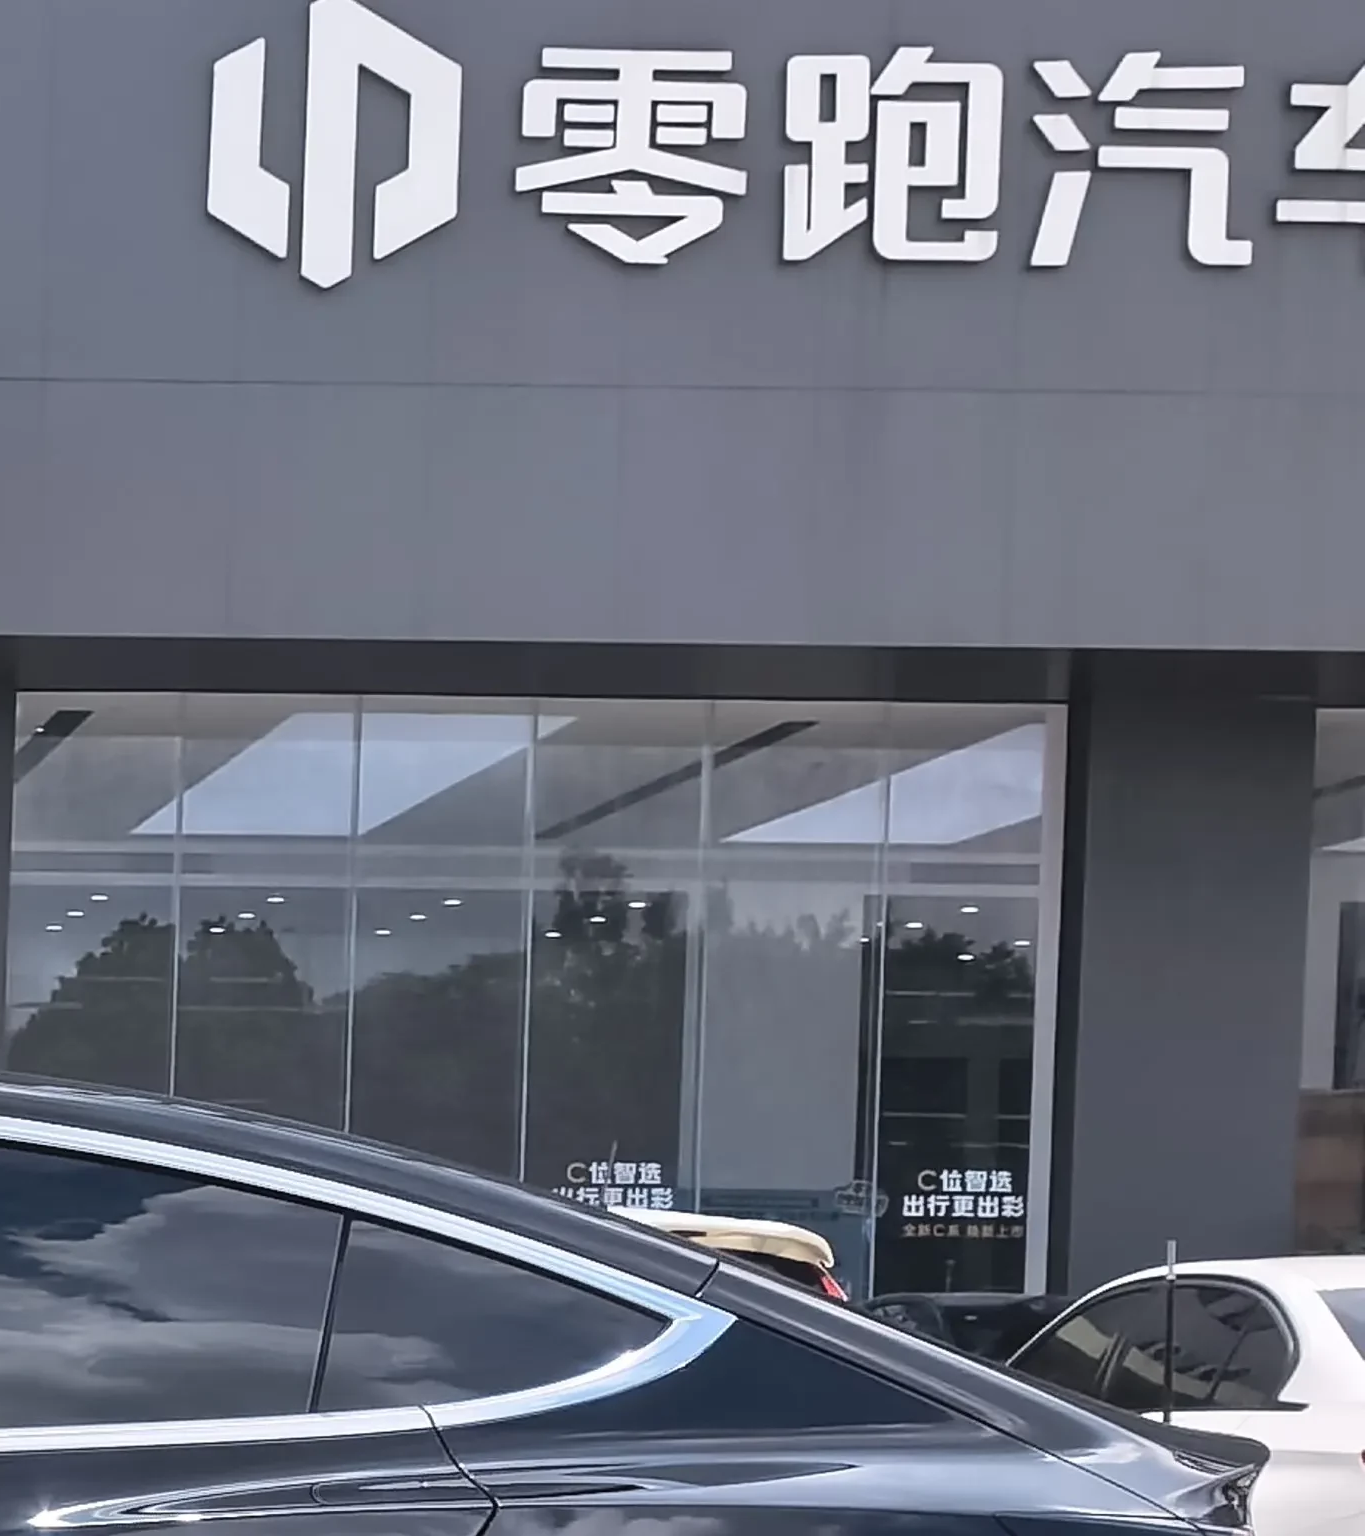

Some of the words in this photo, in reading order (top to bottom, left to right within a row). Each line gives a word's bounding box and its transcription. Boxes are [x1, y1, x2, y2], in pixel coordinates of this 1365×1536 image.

[567, 1162, 662, 1185] C位智选
[917, 1169, 1013, 1193] C位智选
[902, 1194, 1025, 1218] 出行更出彩
